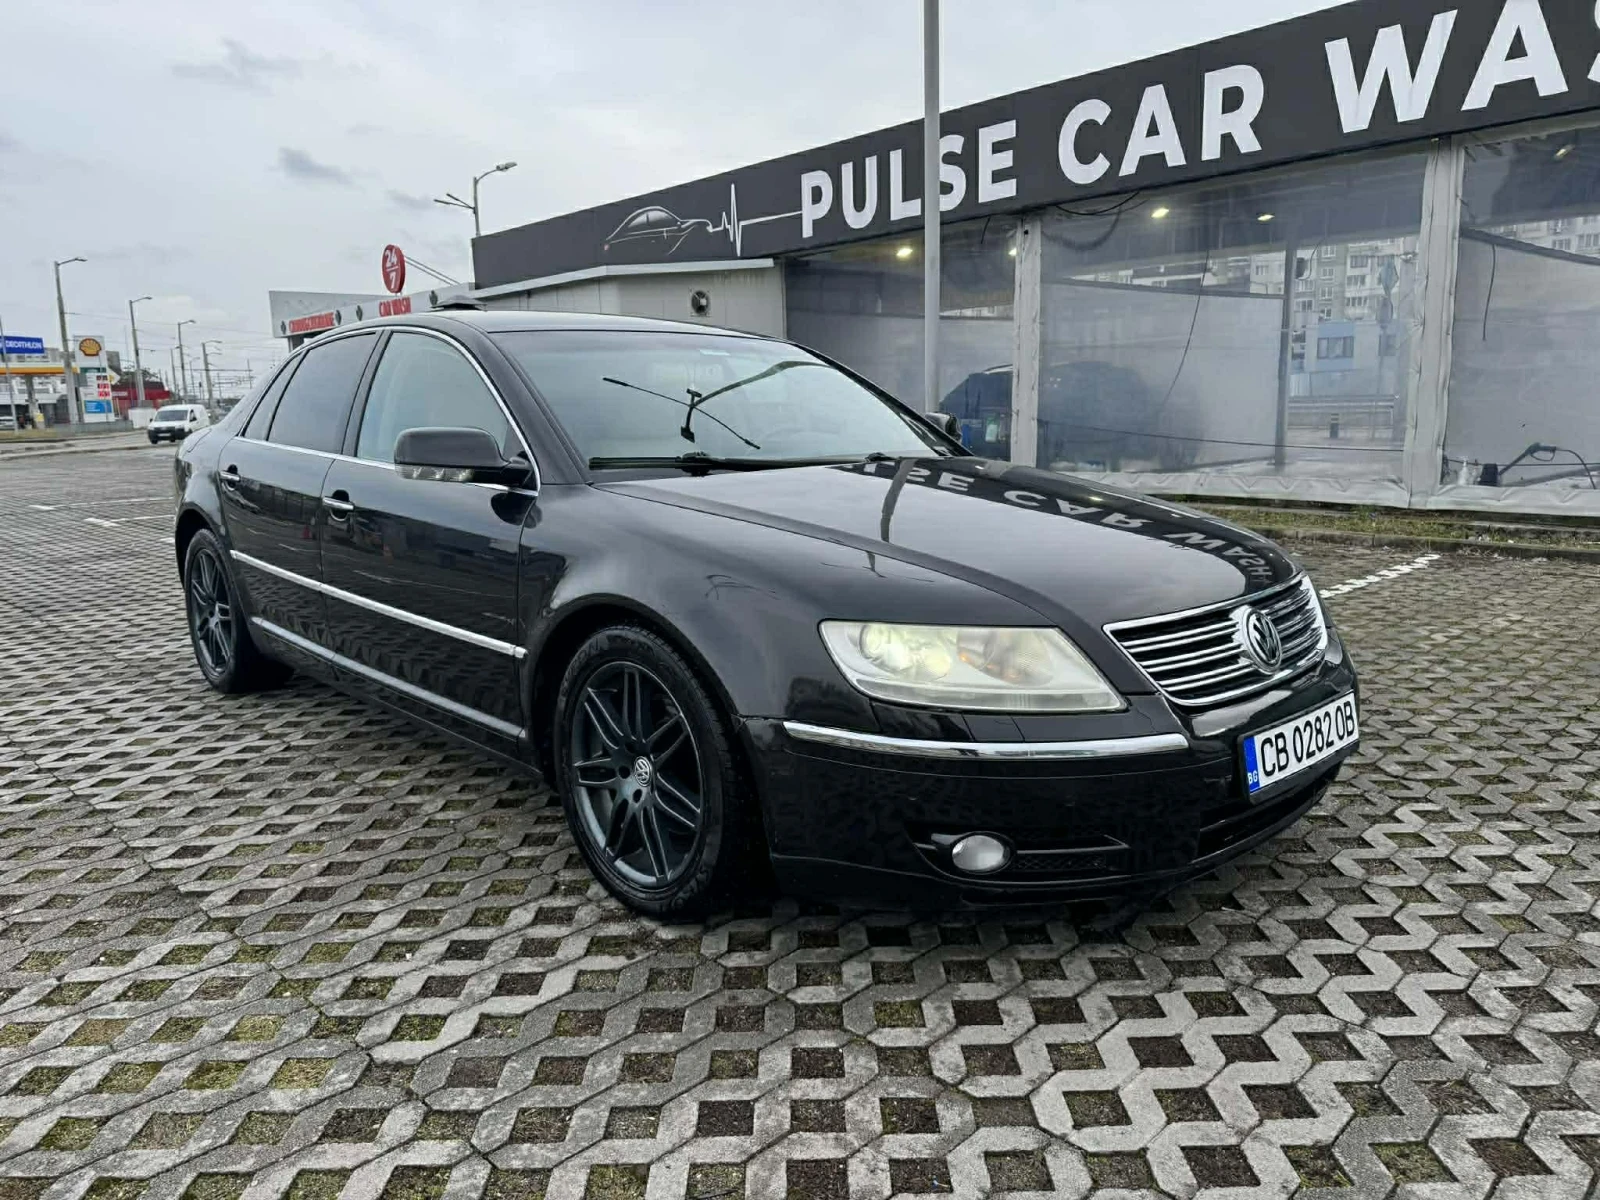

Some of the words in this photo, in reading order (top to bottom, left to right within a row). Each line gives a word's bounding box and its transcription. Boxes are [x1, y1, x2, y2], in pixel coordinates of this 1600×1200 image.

[801, 119, 1017, 238] PULSE
[1058, 64, 1264, 185] CAR
[1324, 0, 1600, 133] WA
[384, 248, 398, 267] 24
[389, 271, 397, 290] 7
[1260, 731, 1290, 778] CB
[1292, 710, 1335, 764] 0282
[1335, 700, 1355, 741] OB
[1246, 770, 1258, 785] BG
